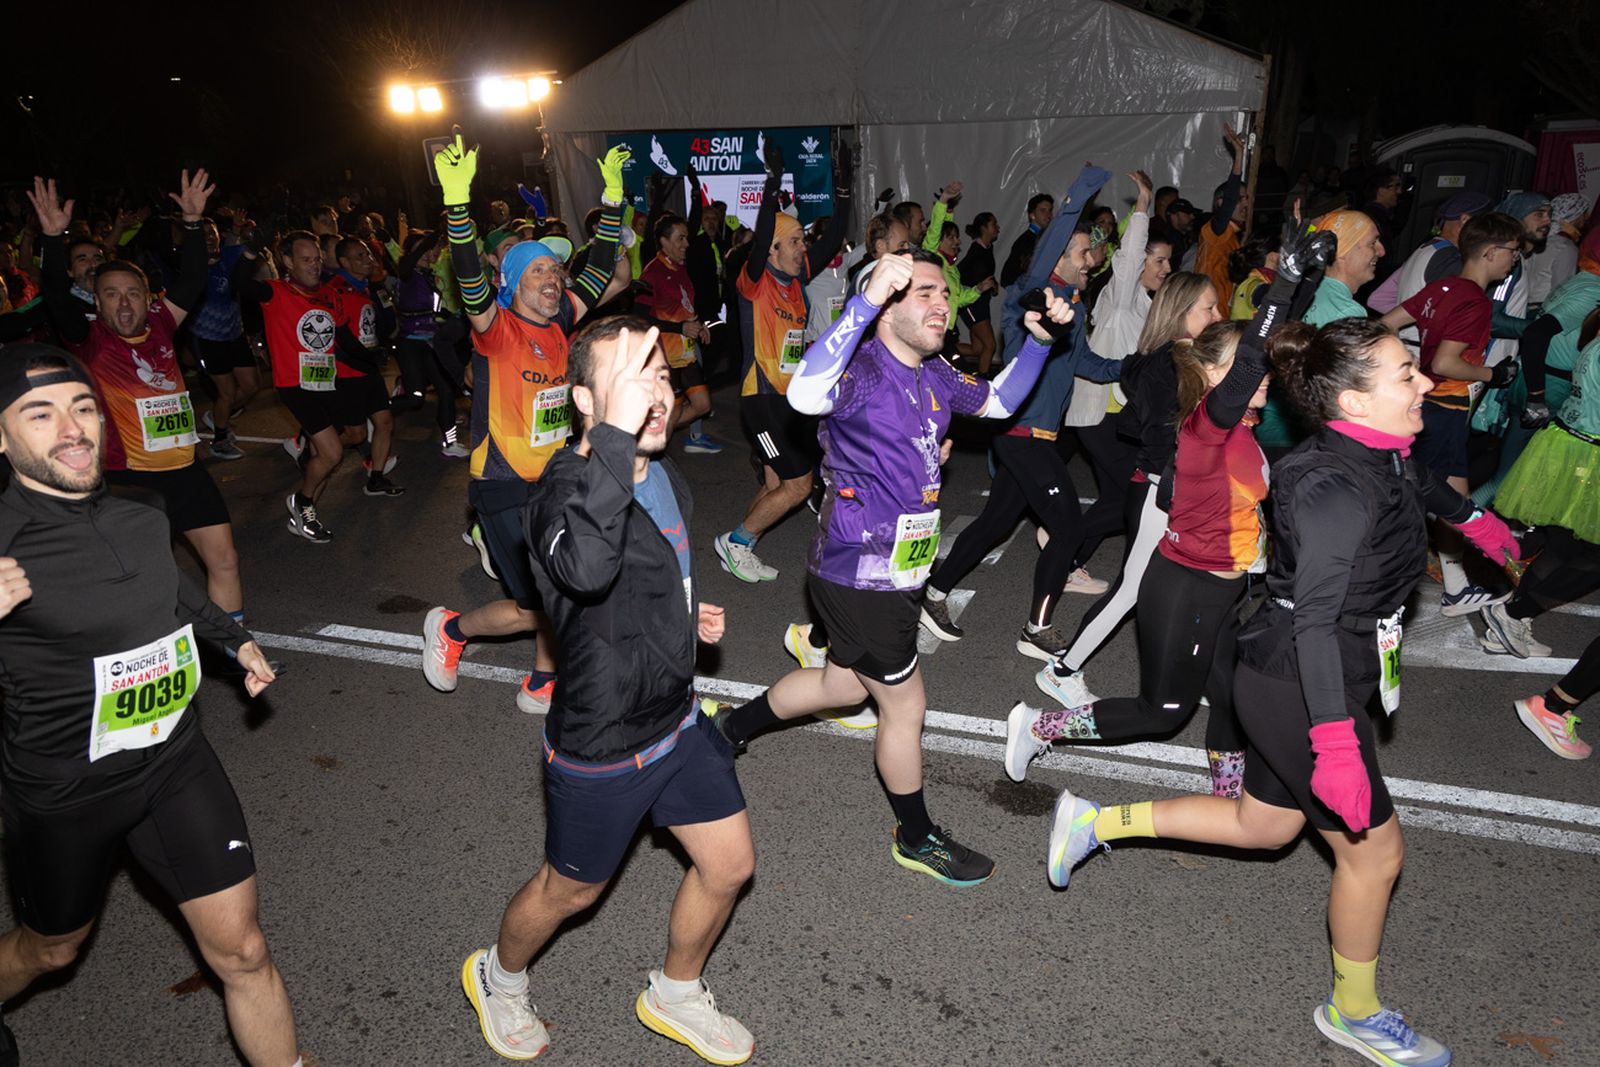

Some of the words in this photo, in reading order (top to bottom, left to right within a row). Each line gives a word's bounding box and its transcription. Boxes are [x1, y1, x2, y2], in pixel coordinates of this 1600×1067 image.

[691, 137, 710, 155] 43
[710, 137, 744, 153] SAN
[690, 153, 742, 172] ANTÓN
[1258, 304, 1277, 338] KIPRUN
[310, 366, 330, 378] 7152
[155, 411, 189, 433] 2676
[543, 404, 570, 425] 4626
[1380, 637, 1396, 650] SAN
[126, 655, 157, 674] NOCHE
[158, 650, 169, 661] DE
[111, 676, 135, 691] SAN
[115, 669, 187, 719] 9039
[133, 713, 156, 726] Miguel
[480, 962, 492, 997] HOKA
